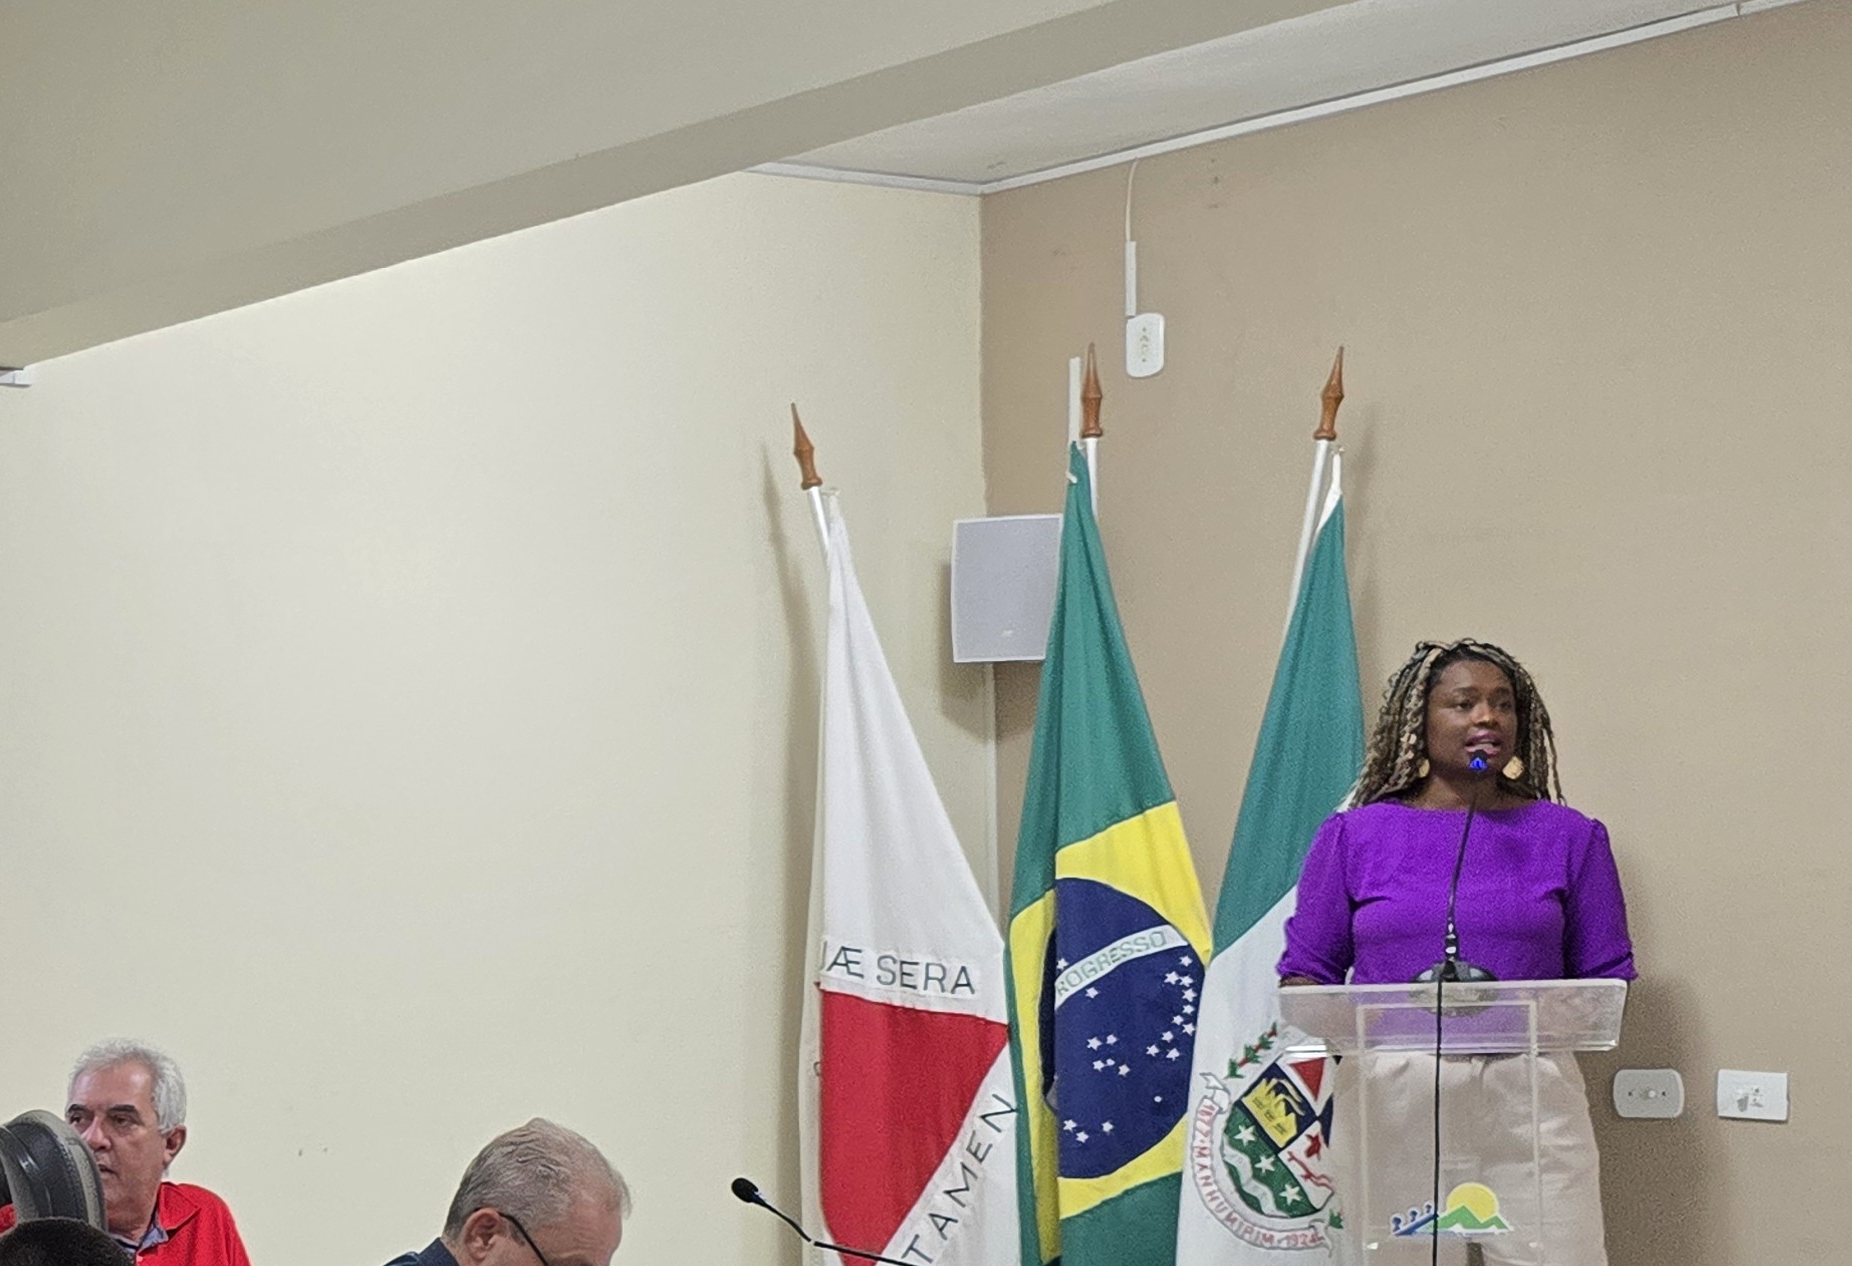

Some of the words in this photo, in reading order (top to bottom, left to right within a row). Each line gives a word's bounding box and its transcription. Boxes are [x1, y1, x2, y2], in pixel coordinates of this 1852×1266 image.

[876, 954, 976, 995] SERA
[1056, 930, 1167, 997] ROGRESSO
[901, 1093, 1018, 1264] TAMEN
